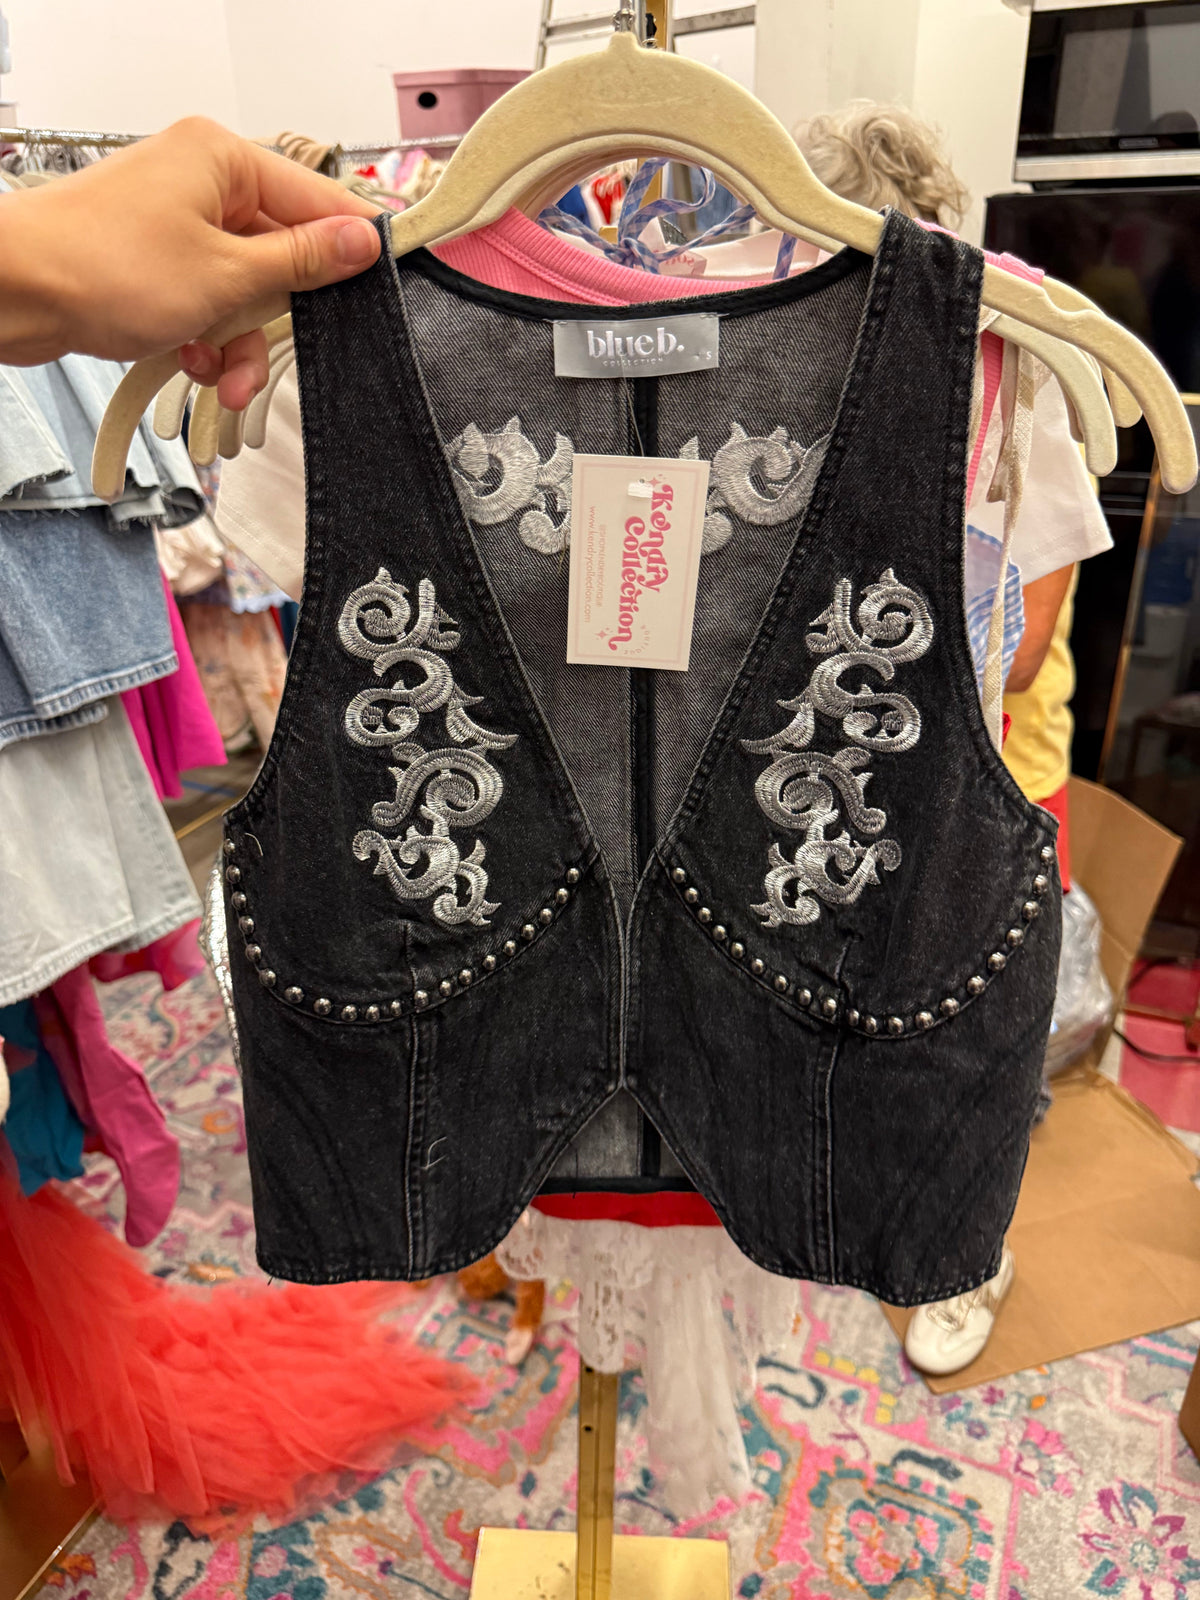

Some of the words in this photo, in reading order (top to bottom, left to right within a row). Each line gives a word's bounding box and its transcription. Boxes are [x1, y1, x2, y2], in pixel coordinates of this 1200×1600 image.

[584, 506, 599, 623] www.kendrycollection.com
[608, 516, 646, 651] Collection
[637, 484, 674, 593] Kendry
